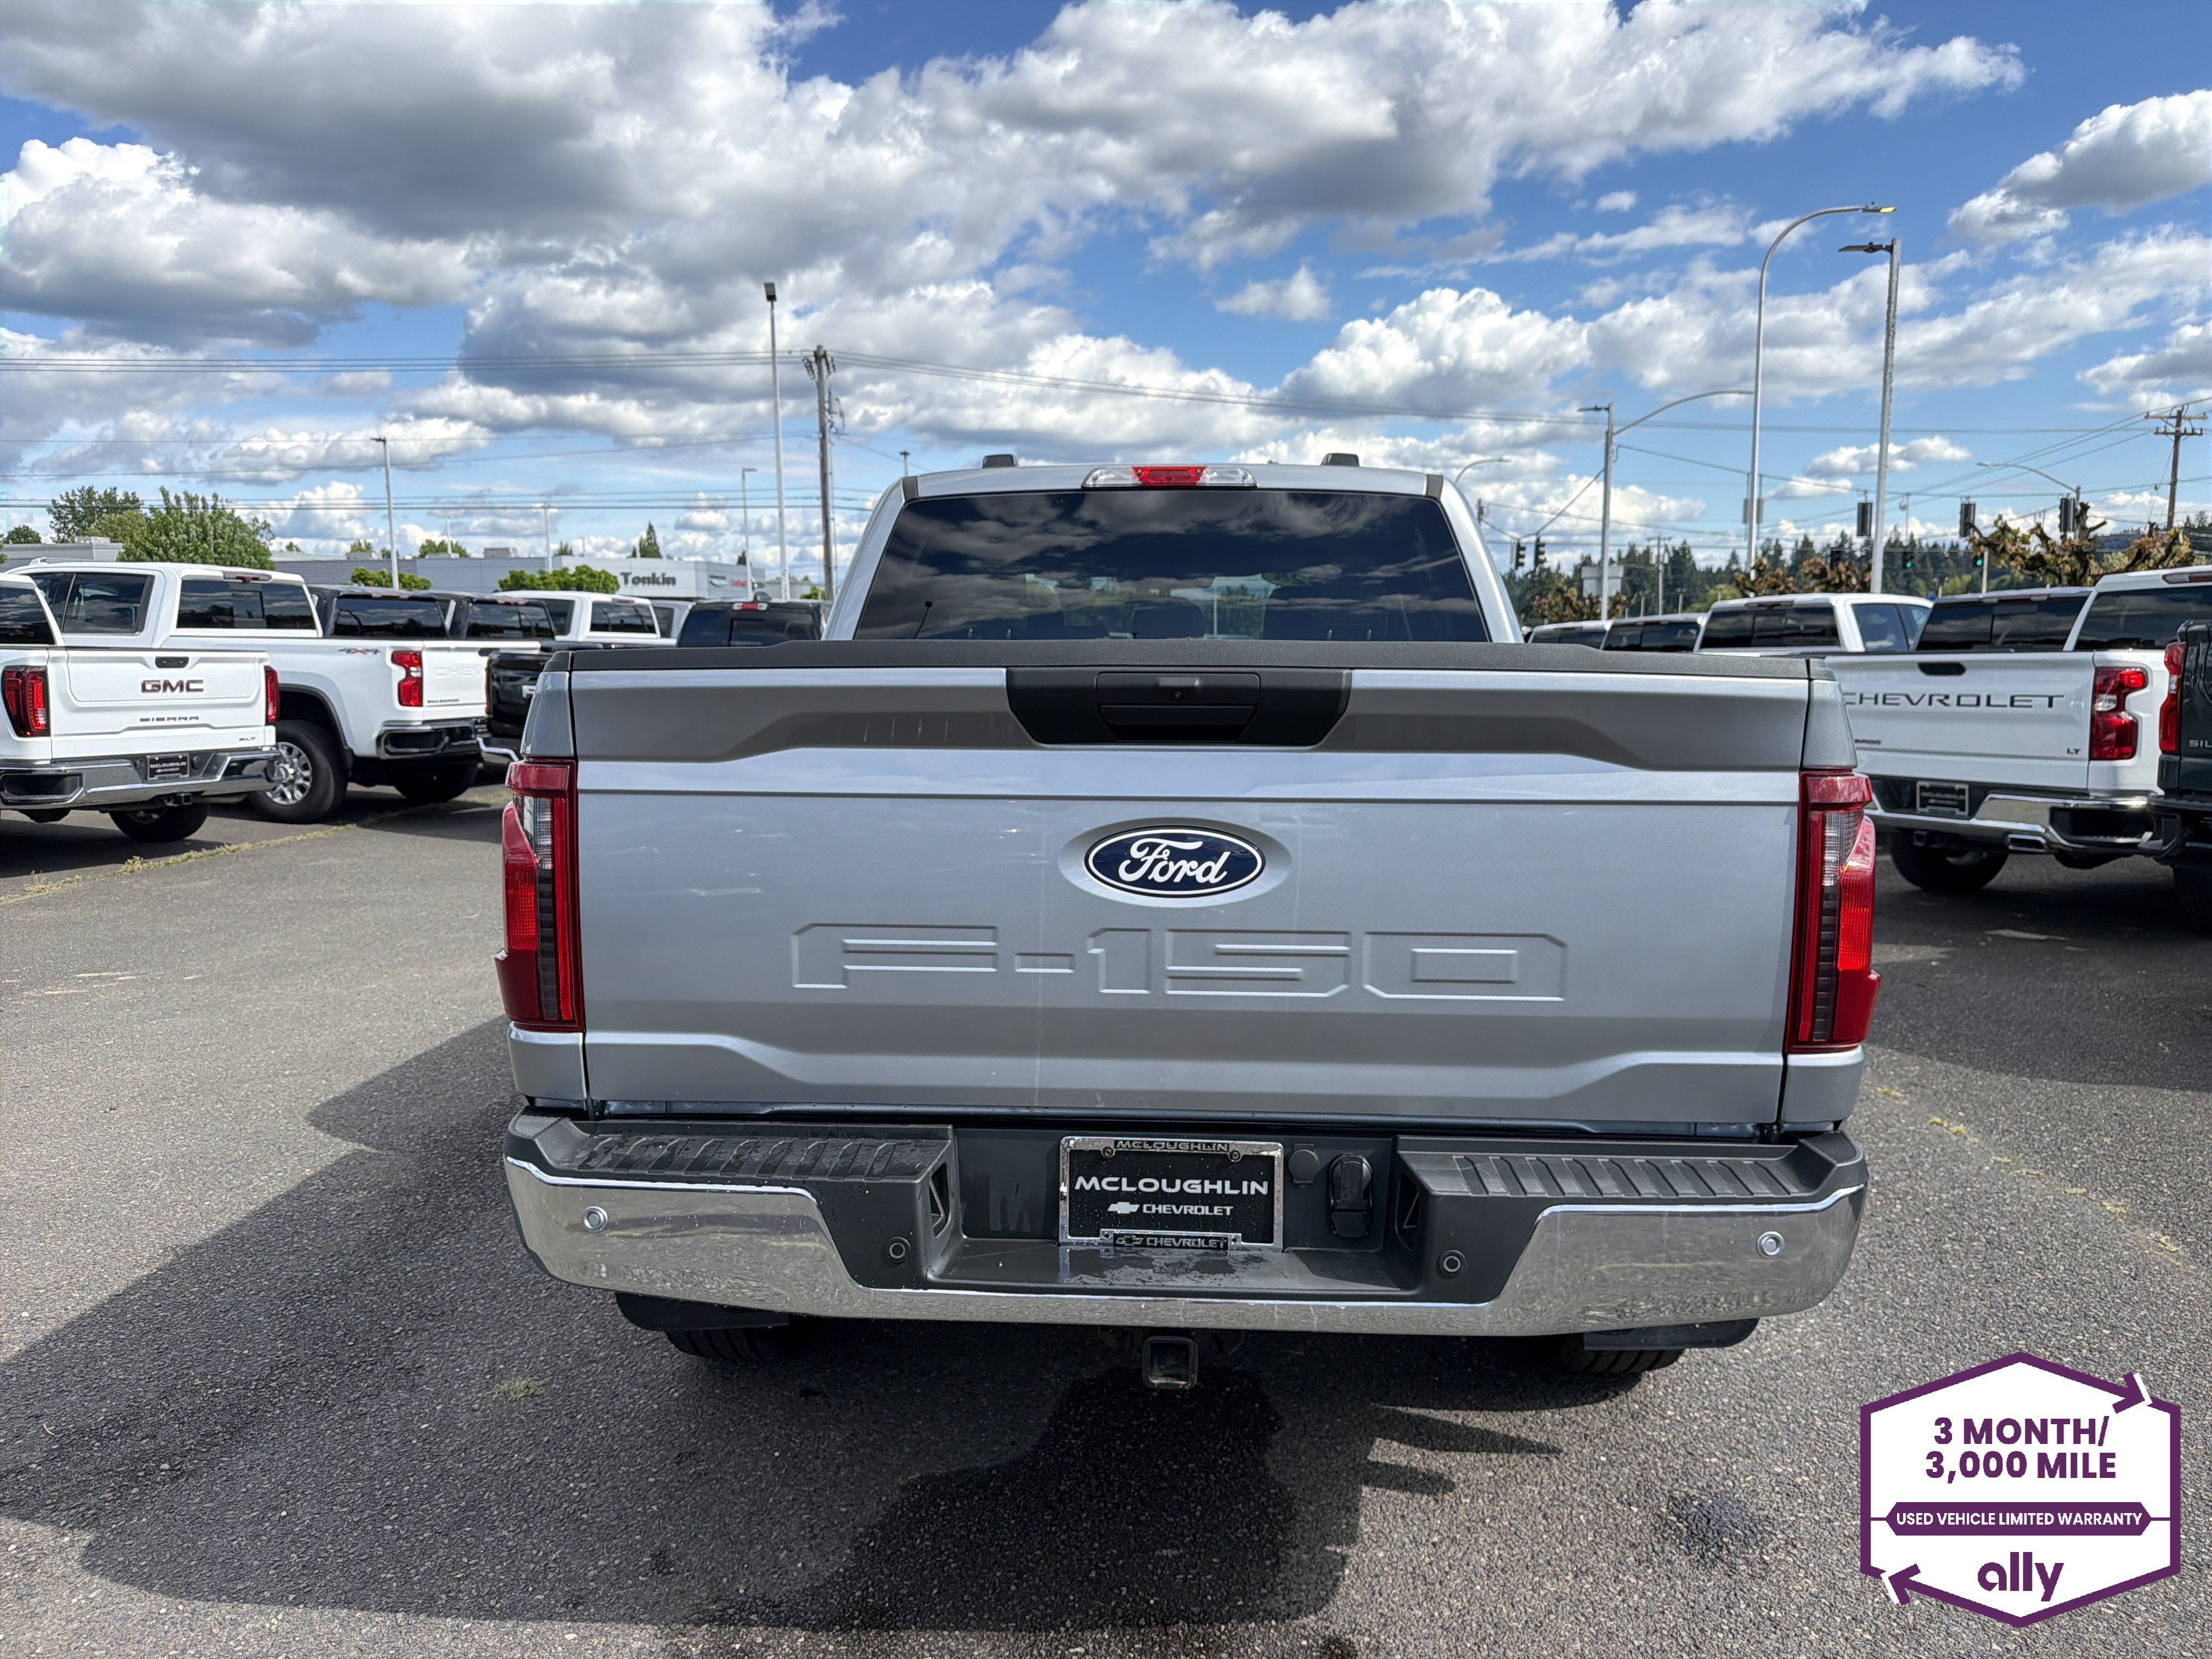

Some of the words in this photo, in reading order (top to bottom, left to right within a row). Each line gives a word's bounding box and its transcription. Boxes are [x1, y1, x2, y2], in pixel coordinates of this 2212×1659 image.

[620, 572, 676, 585] Tonkin
[141, 679, 204, 693] GMC
[1842, 692, 2064, 709] CHEVROLET
[1119, 838, 1231, 884] Ford
[791, 923, 1568, 1002] F-150
[1115, 1140, 1229, 1152] MCLOUGHLIN
[1074, 1176, 1268, 1195] MCLOUGHLIN
[1142, 1204, 1234, 1216] CHEVROLET
[1146, 1235, 1228, 1249] CHEVROLET
